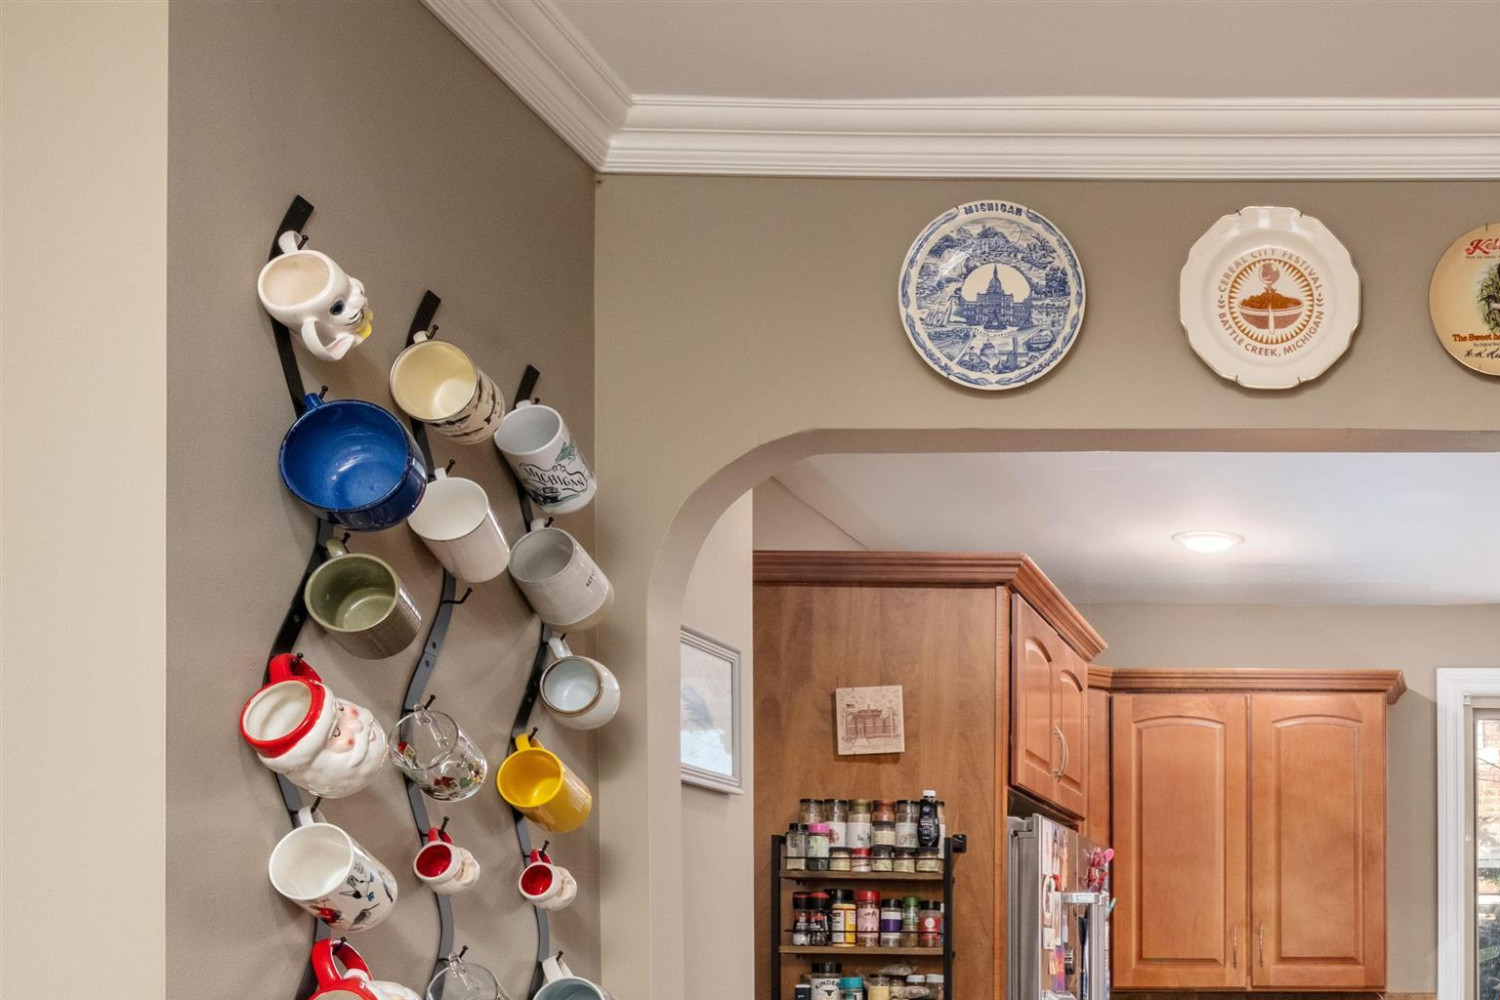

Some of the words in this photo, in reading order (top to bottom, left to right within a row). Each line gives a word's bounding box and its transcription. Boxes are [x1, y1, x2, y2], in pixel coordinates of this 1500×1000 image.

[964, 202, 1023, 216] MICHIGAN
[1219, 256, 1248, 292] CEREAL
[1282, 251, 1324, 292] FESTIVAL
[1218, 312, 1246, 346] BATTLE
[1244, 342, 1281, 357] CREEK,
[1283, 310, 1325, 356] MICHIGAN
[1453, 334, 1468, 342] The
[1468, 333, 1492, 342] Sweet
[524, 467, 585, 487] MICHIGAN
